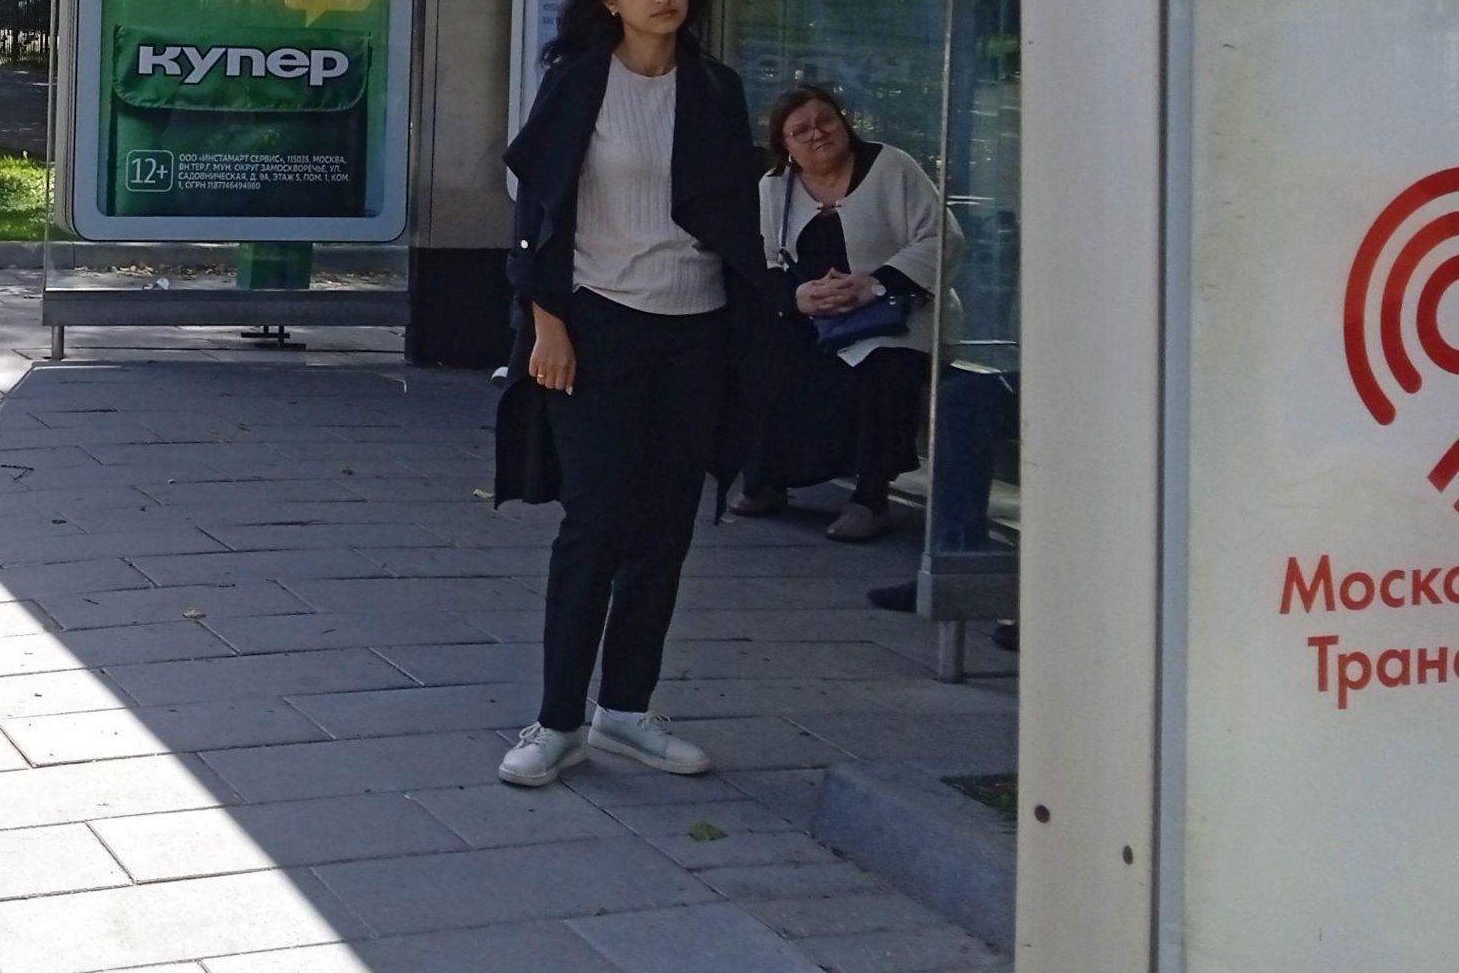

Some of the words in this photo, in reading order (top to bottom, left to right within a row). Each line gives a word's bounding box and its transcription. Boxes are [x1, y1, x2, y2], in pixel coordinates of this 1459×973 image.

[138, 44, 350, 86] купер
[179, 154, 198, 163] ООО
[130, 157, 168, 184] 12+
[234, 163, 260, 172] ОКРУГ
[272, 173, 294, 182] ЭТАЖ
[185, 181, 206, 190] ОГРН
[1308, 634, 1459, 710] Тран
